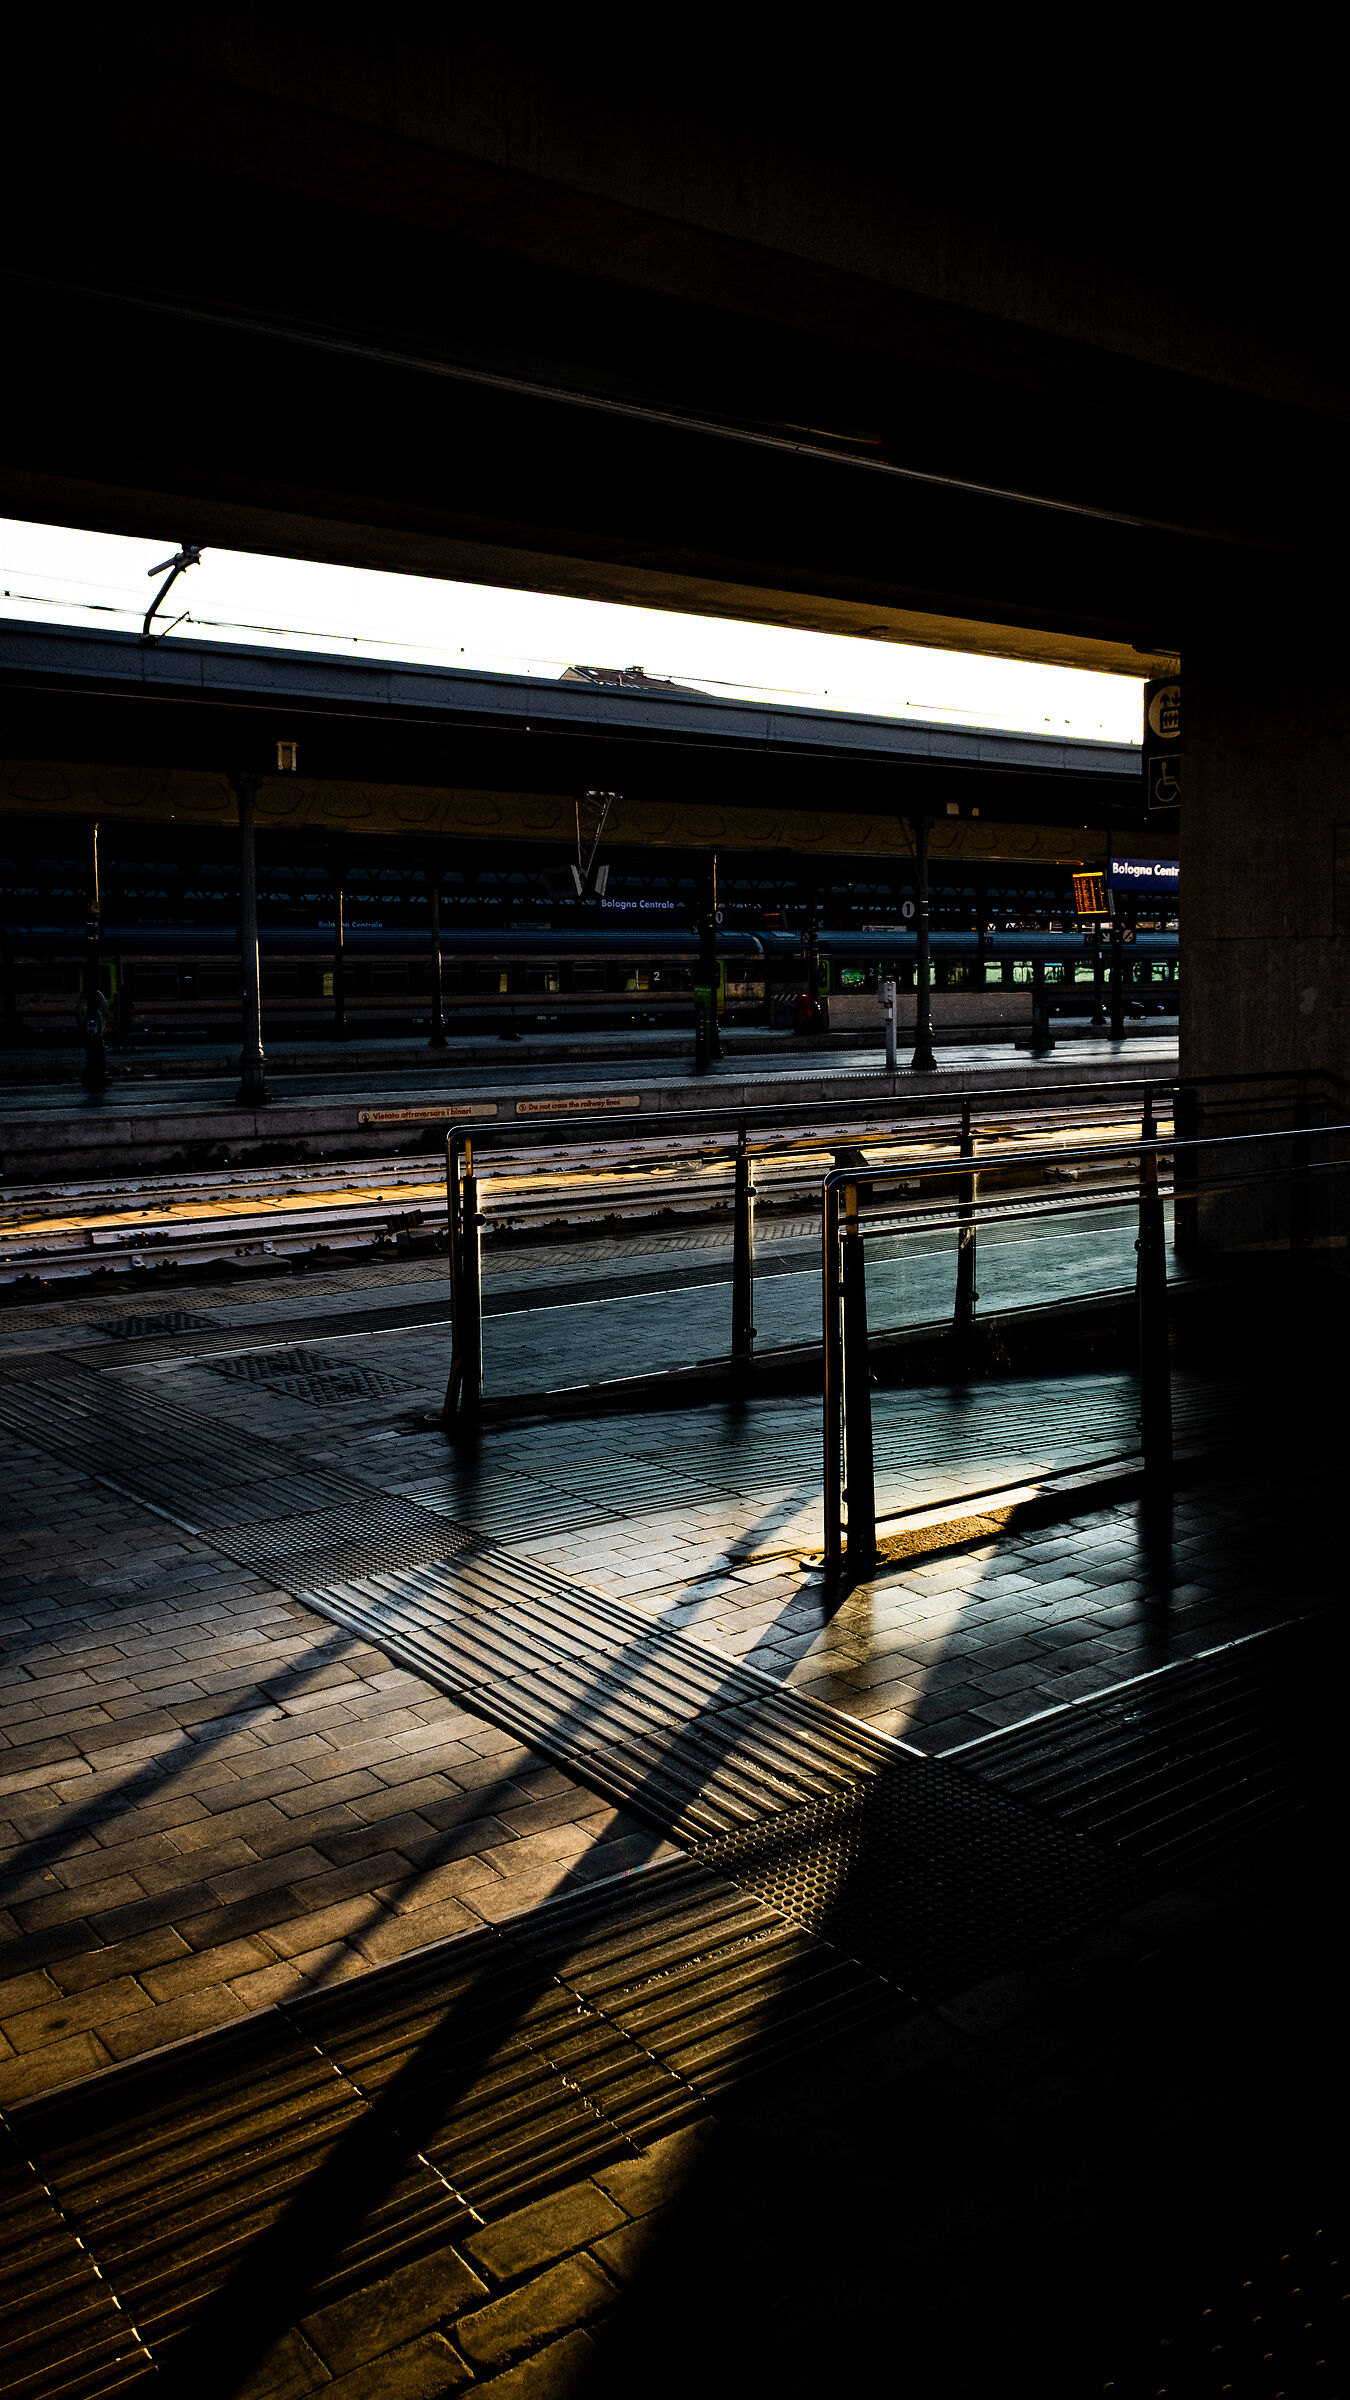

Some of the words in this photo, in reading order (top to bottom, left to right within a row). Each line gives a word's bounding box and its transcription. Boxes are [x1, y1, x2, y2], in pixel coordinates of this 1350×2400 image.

[1112, 862, 1153, 877] Bologna
[1154, 864, 1179, 876] Centr
[601, 899, 637, 909] Bologna
[639, 900, 675, 909] Centrale
[653, 971, 660, 981] 2
[373, 1112, 400, 1120] Vietato
[400, 1110, 446, 1118] attraversare
[450, 1107, 472, 1115] binari
